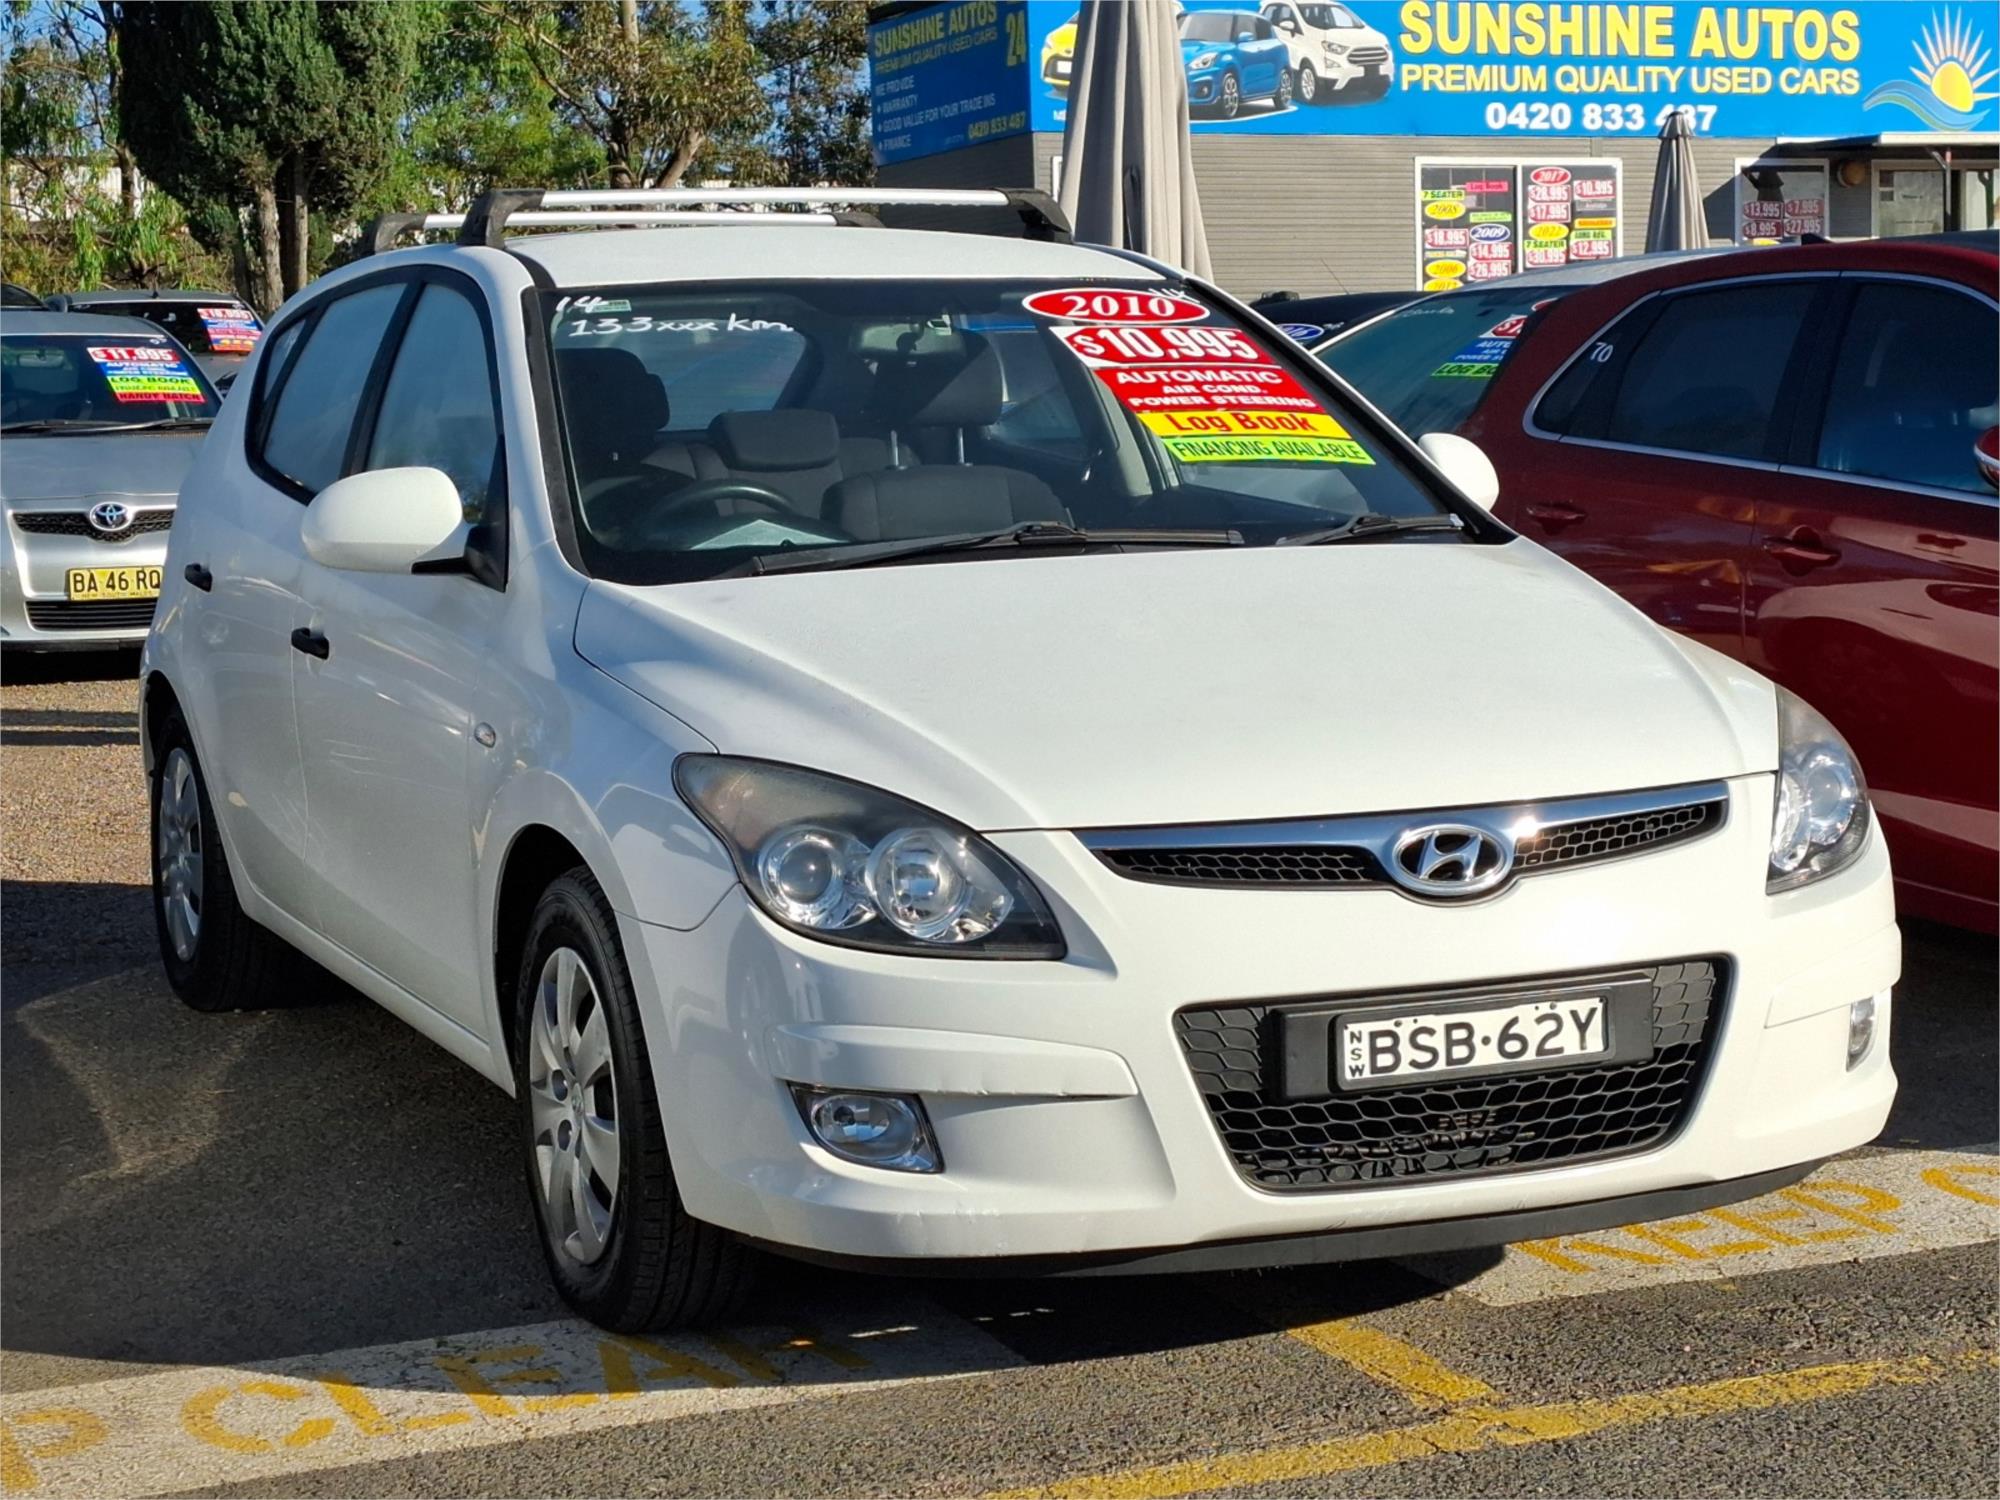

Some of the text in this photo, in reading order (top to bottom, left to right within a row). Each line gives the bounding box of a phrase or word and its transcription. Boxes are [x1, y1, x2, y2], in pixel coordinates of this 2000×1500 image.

[874, 1, 997, 57] SUNSHINE AUTOS
[1006, 10, 1026, 67] 24
[1400, 1, 1861, 61] SUNSHINE AUTOS
[913, 42, 947, 64] QUALITY
[948, 34, 972, 54] USED
[974, 26, 997, 45] CARS
[1402, 64, 1861, 95] PREMIUM QUALITY USED CARS
[903, 111, 924, 128] VALUE
[925, 107, 939, 123] FOR
[940, 102, 959, 118] YOUR
[960, 96, 983, 113] TRADE
[1485, 102, 1572, 130] 0420
[1582, 103, 1645, 131] 833
[1744, 202, 1780, 217] $13,995
[1474, 226, 1507, 238] 2009
[1744, 222, 1777, 236] $8,995
[1062, 294, 1176, 318] 2010
[94, 348, 173, 361] $11,995
[1074, 327, 1260, 361] $10,995
[148, 376, 191, 384] BOOK
[1116, 369, 1283, 385] AUTOMATIC
[1439, 365, 1475, 374] LOG
[1162, 384, 1268, 395] AIR COND.
[1128, 395, 1316, 408] POWER STEERING
[1163, 413, 1318, 433] Log Book
[1173, 442, 1367, 461] FINANCING AVAILABLE
[73, 571, 98, 593] BA
[106, 570, 129, 591] 46
[180, 1331, 875, 1454] CLEAR
